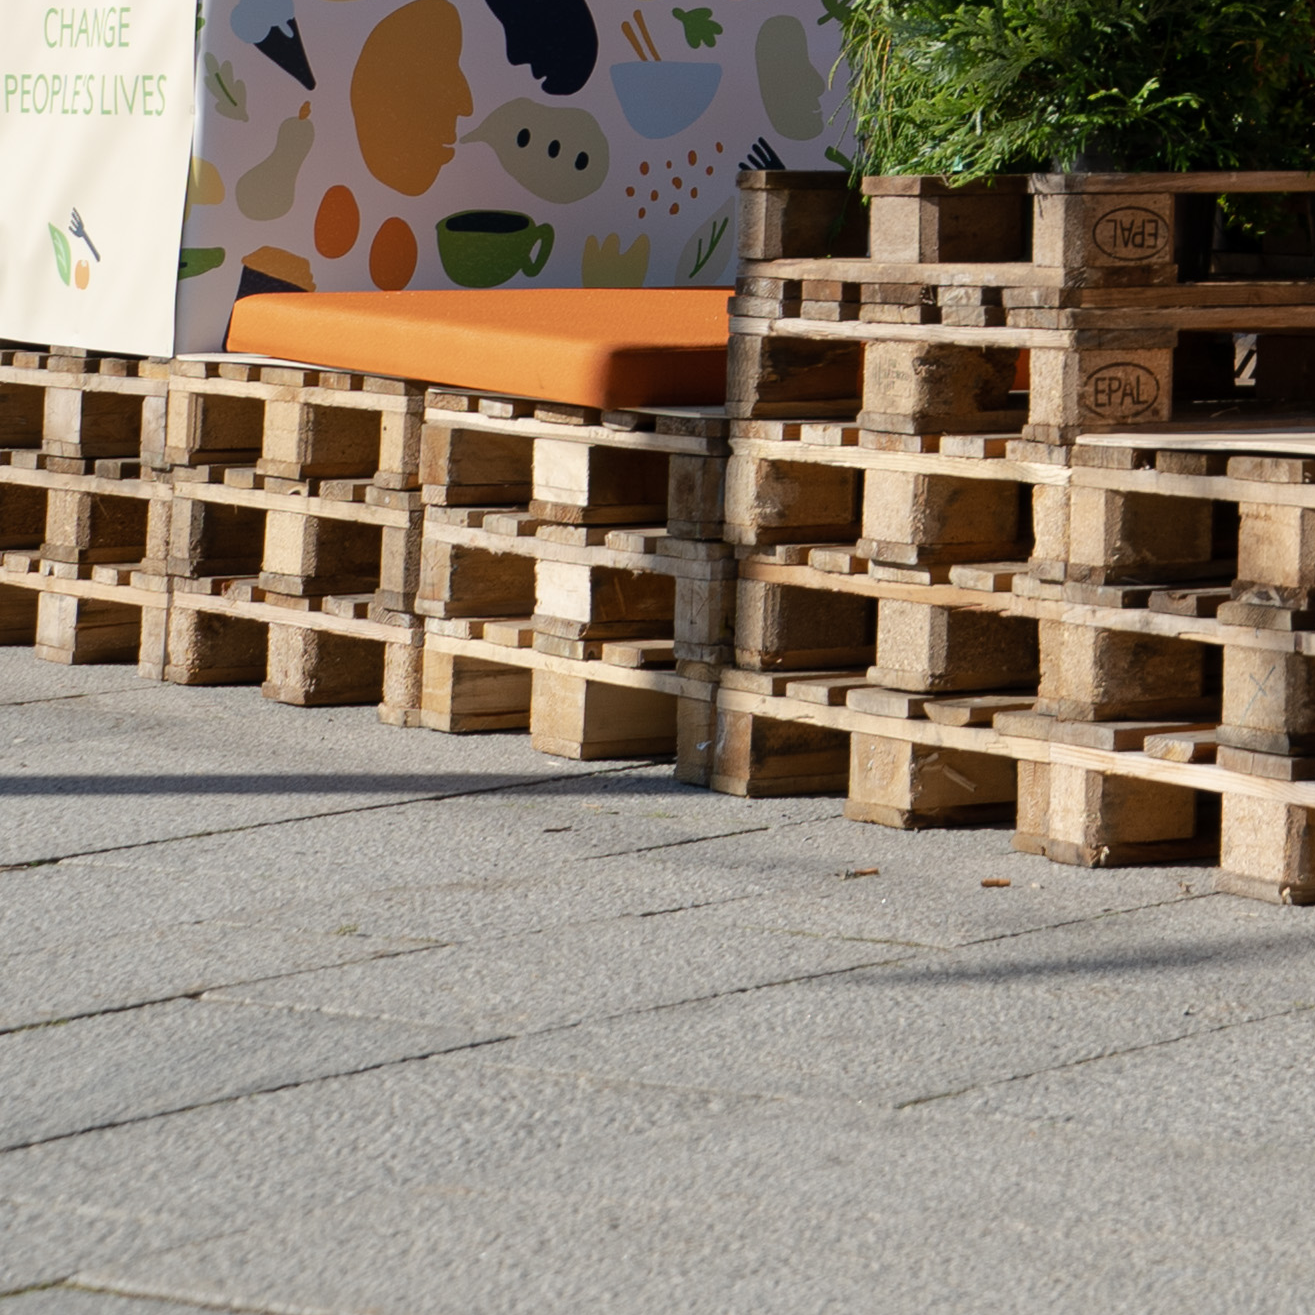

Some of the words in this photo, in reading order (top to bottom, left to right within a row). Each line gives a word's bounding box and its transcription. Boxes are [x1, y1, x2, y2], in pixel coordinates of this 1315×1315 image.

[44, 7, 131, 48] CHANGE
[101, 74, 167, 116] LIVES
[1105, 219, 1158, 248] EPAL
[1094, 376, 1149, 408] EPAL
